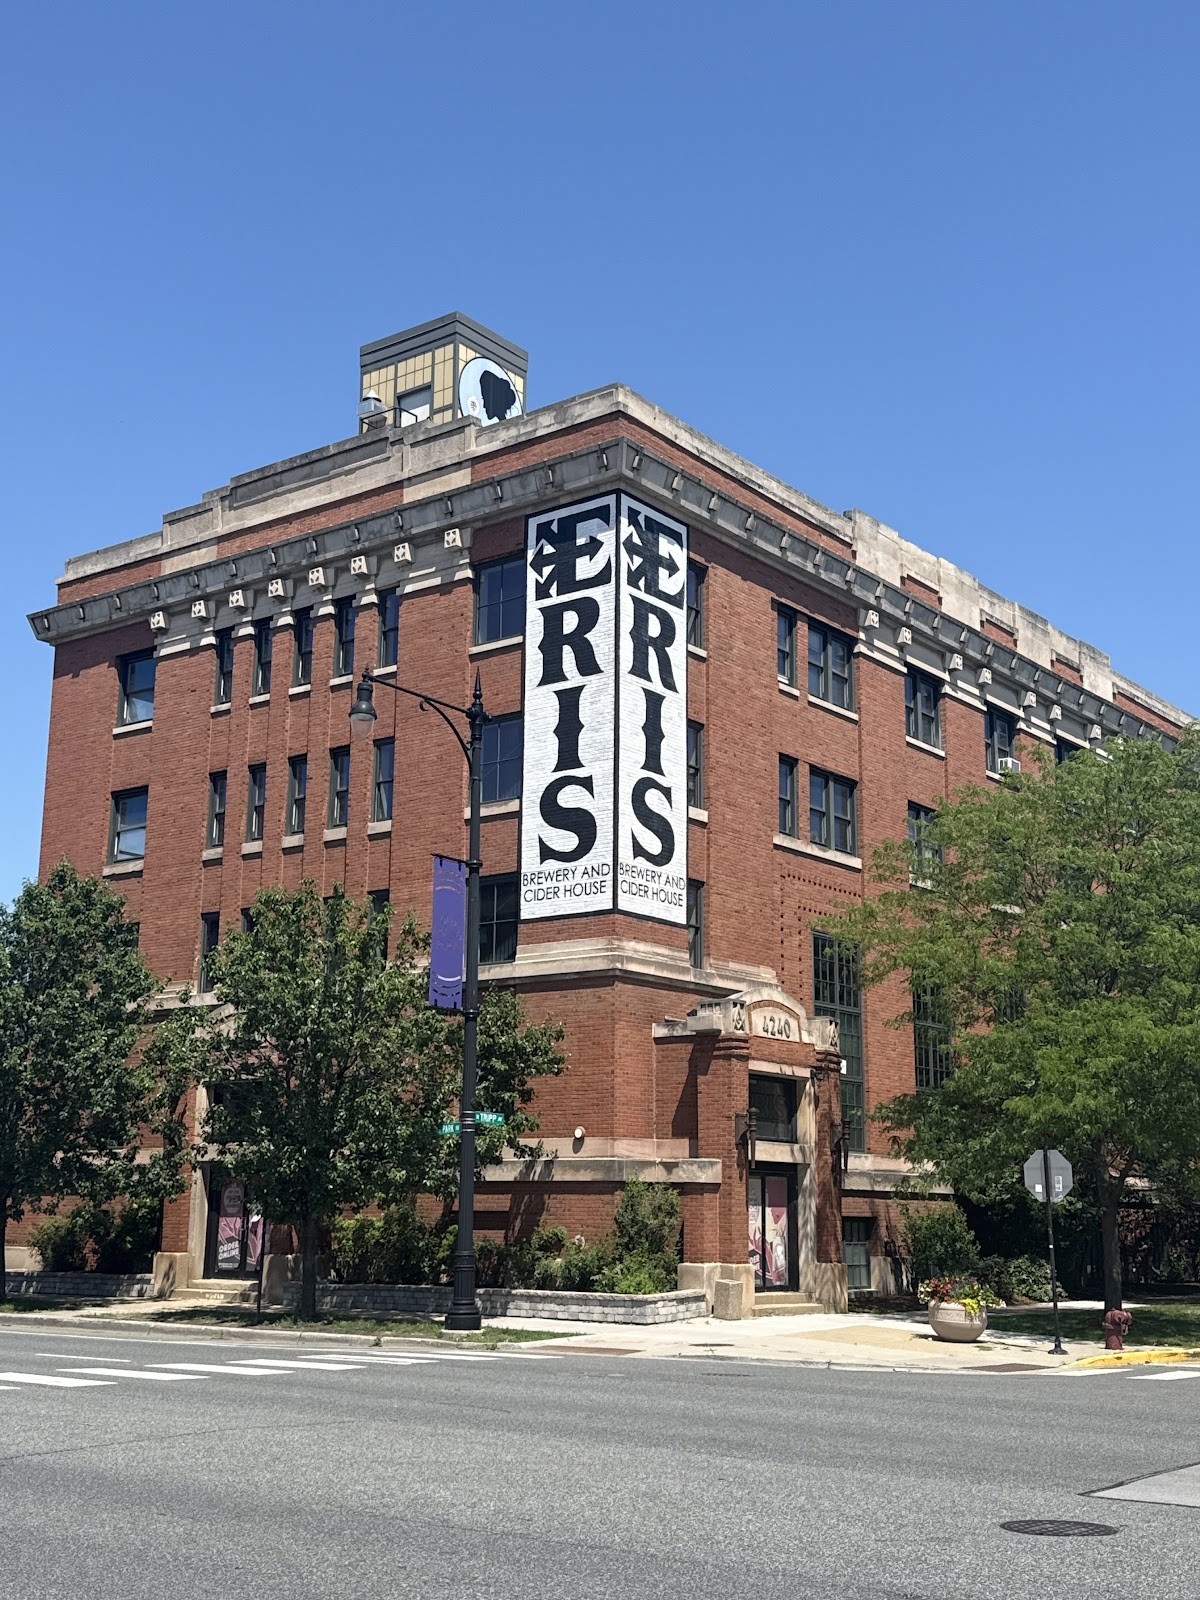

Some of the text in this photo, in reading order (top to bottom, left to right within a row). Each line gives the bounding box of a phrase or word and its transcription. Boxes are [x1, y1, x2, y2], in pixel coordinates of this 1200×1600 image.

[529, 503, 612, 864] ERIS
[622, 505, 686, 868] ERIS
[522, 863, 611, 887] BREWERY AND
[619, 862, 686, 891] BREWERY AND
[523, 880, 607, 903] CIDER HOUSE
[620, 880, 683, 907] CIDER HOUSE
[762, 1015, 791, 1039] 4240
[442, 1124, 454, 1133] PARK
[480, 1113, 497, 1123] TRIPP
[218, 1240, 239, 1253] ORDER
[218, 1248, 240, 1260] ONLINE
